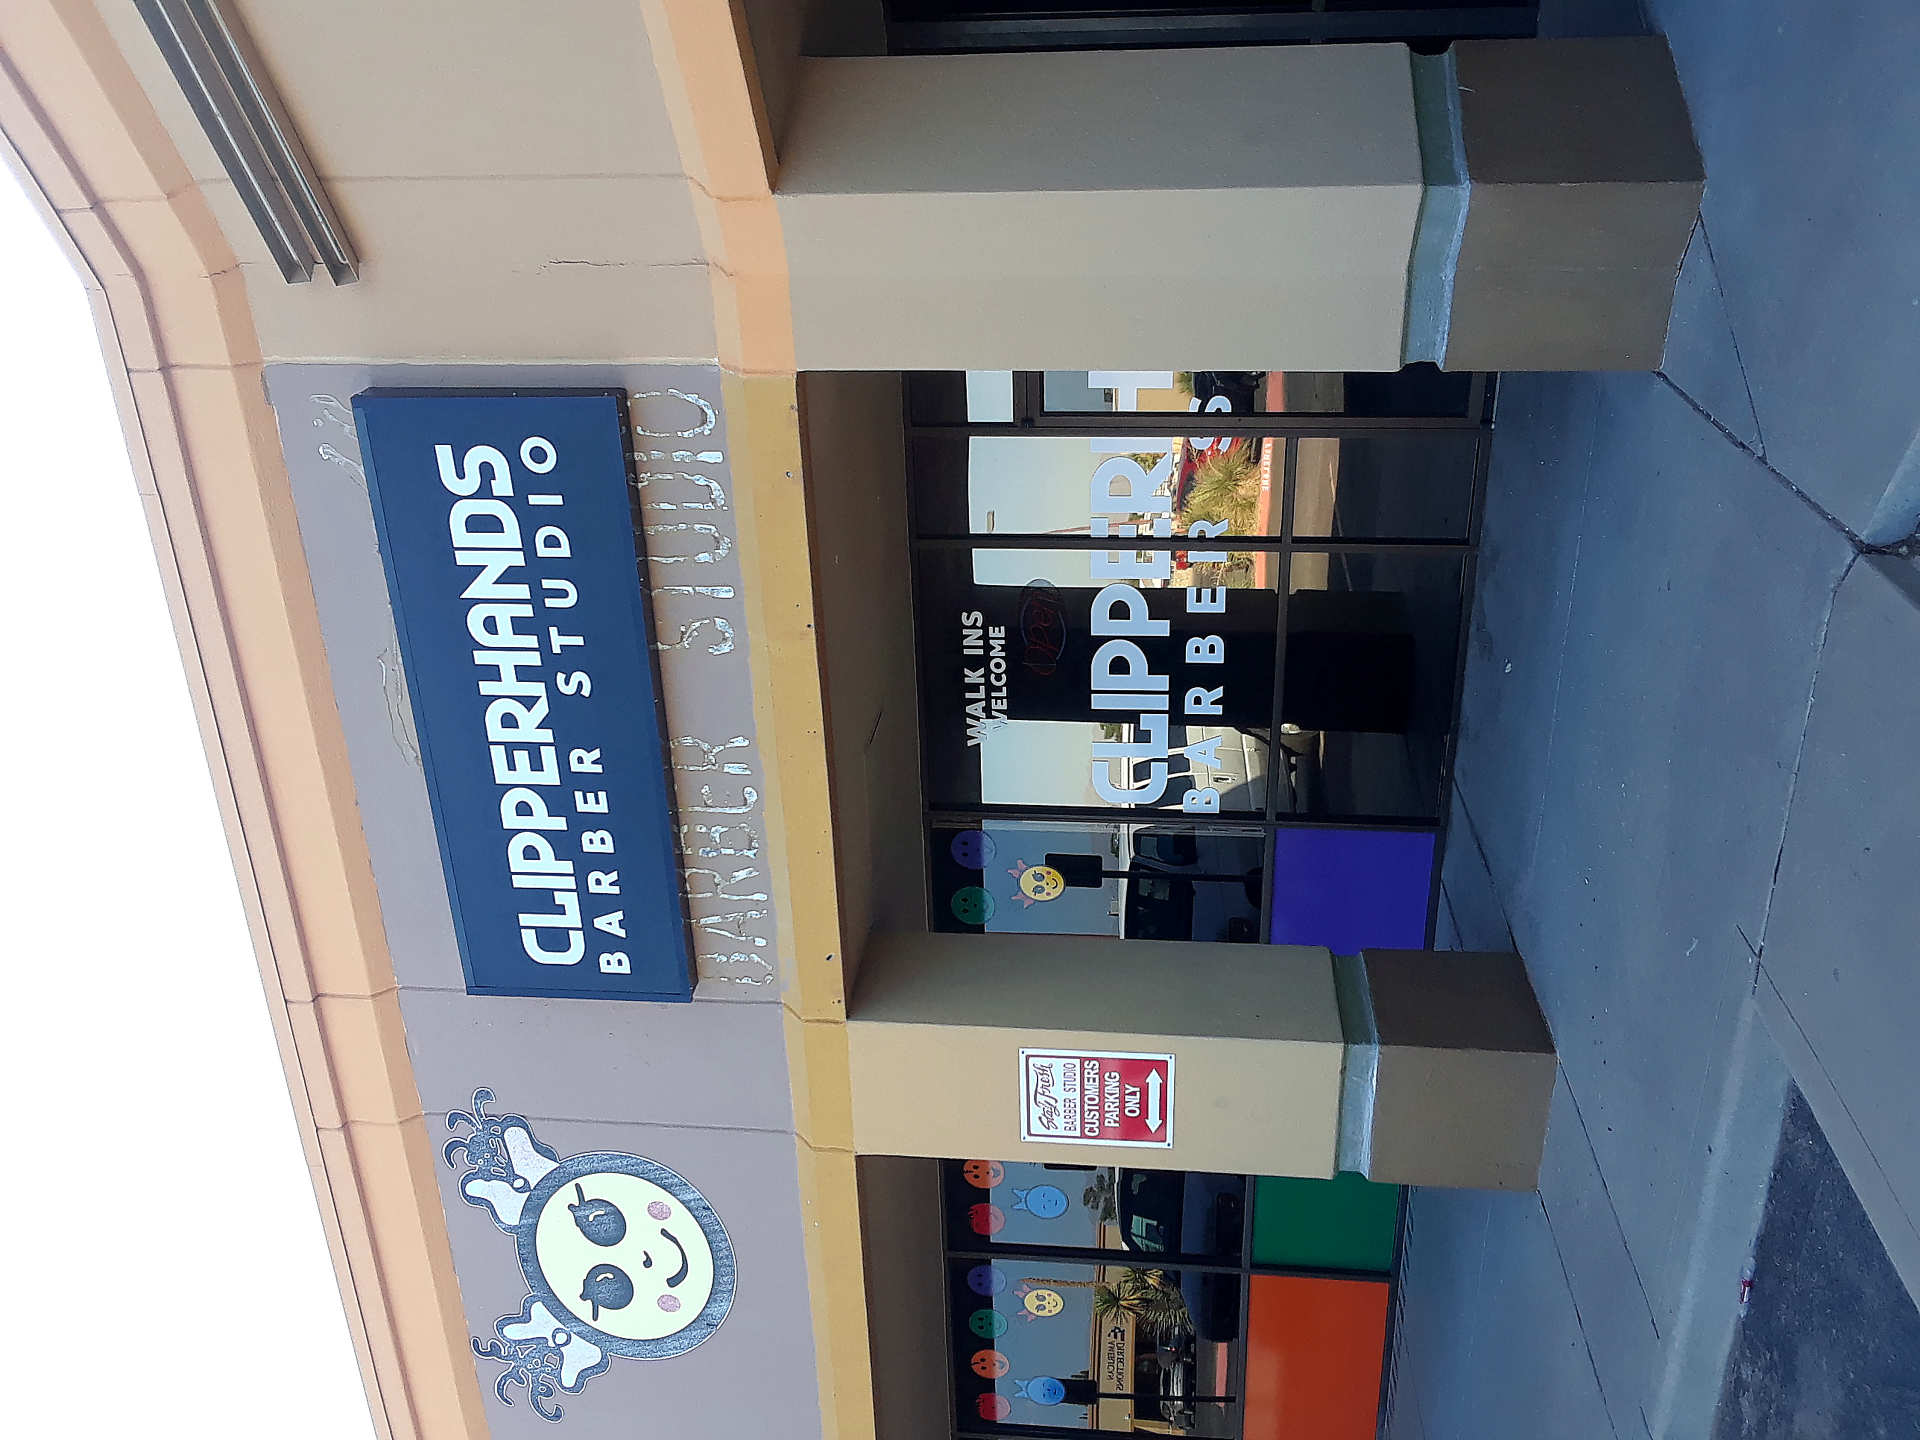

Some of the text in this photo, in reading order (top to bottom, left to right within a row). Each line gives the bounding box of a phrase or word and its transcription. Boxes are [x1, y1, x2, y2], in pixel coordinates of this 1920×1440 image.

[434, 444, 586, 966] CLIPPERHANDS
[520, 435, 632, 974] BARBER STUDIO
[961, 610, 988, 746] WALK INS
[988, 625, 1009, 732] WELCOME
[1183, 518, 1230, 814] BARBER
[1032, 1062, 1058, 1107] Fresh
[1063, 1062, 1077, 1132] BARBER STUDIO
[1083, 1060, 1100, 1137] CUSTOMERS
[1104, 1071, 1120, 1128] PARKING
[1124, 1083, 1140, 1117] ONLY
